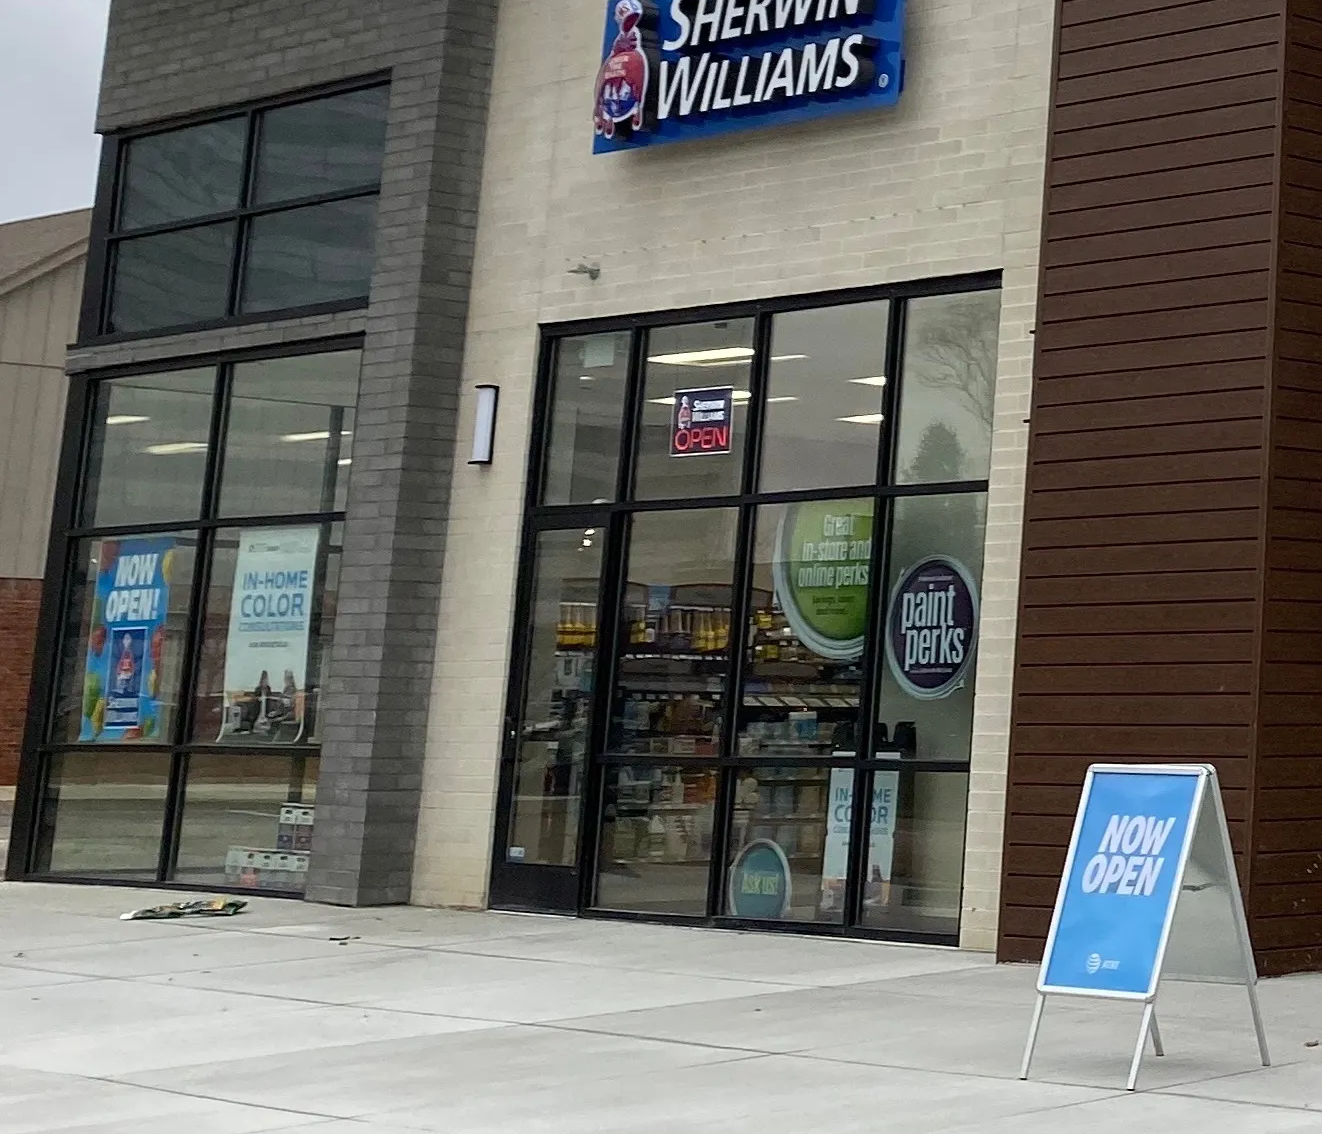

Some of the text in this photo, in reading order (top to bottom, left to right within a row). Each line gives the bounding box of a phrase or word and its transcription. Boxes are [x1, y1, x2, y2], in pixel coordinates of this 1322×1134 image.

[657, 34, 864, 120] WILLIAMS
[675, 426, 728, 450] OPEN
[115, 553, 159, 587] NOW
[243, 570, 308, 590] IN-HOME
[798, 562, 868, 589] online perks
[105, 588, 161, 622] OPEN!
[241, 593, 304, 617] COLOR
[901, 584, 956, 634] paint
[904, 623, 965, 671] perks
[1098, 815, 1176, 856] NOW
[1081, 854, 1165, 896] OPEN
